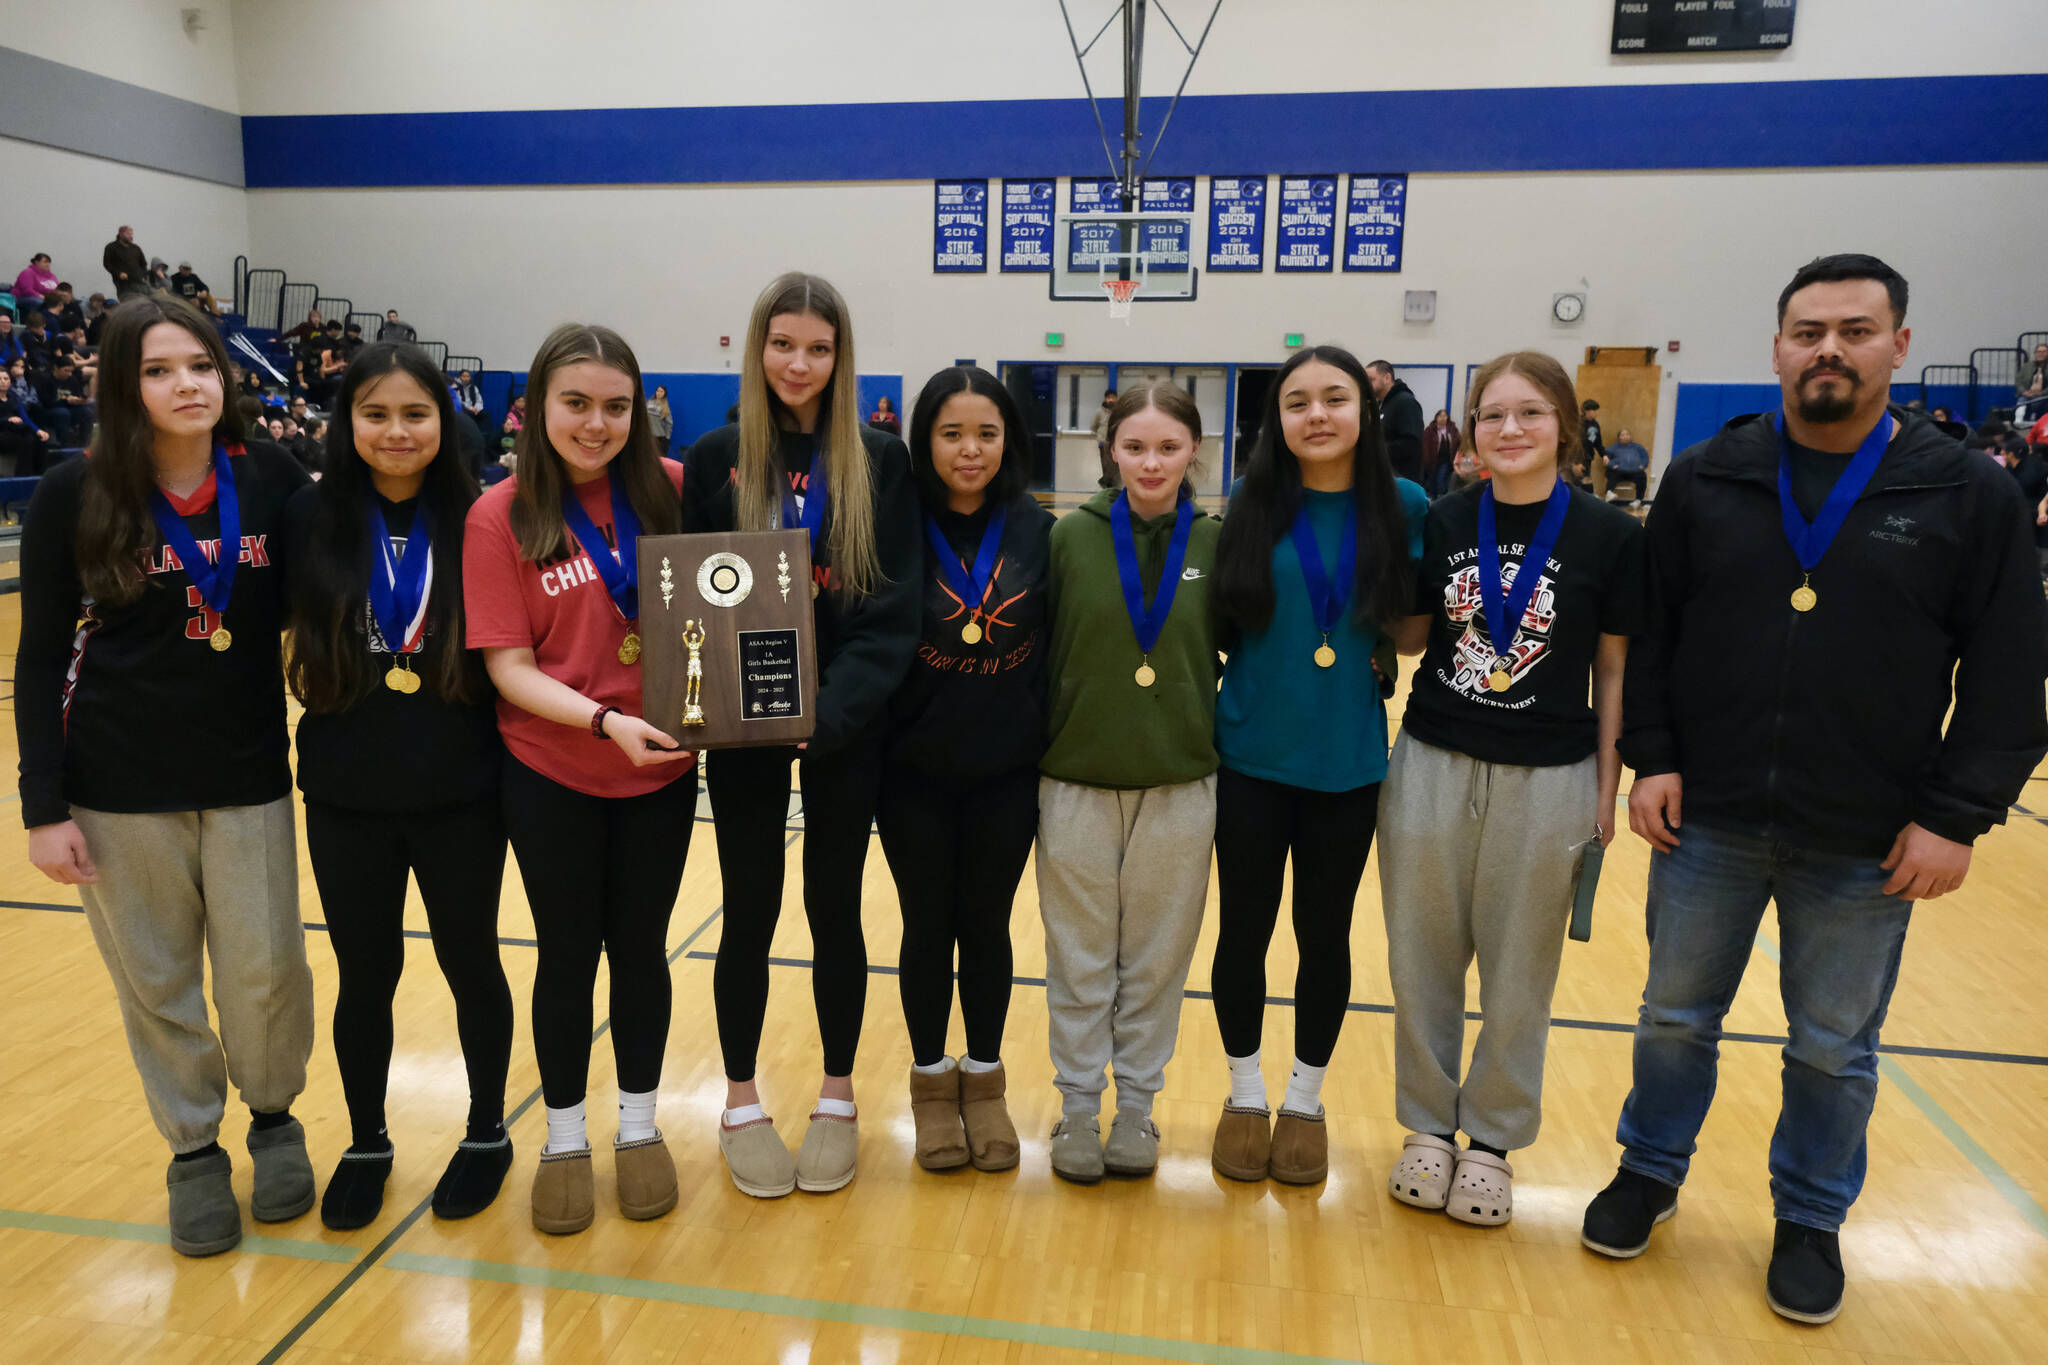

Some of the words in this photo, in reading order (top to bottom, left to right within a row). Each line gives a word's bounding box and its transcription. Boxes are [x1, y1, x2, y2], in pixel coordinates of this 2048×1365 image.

[1620, 4, 1648, 13] FOULS
[1674, 1, 1708, 12] PLAYER
[1713, 0, 1736, 10] FOUL
[1618, 38, 1646, 48] SCORE
[1688, 36, 1717, 46] MATCH
[1760, 34, 1788, 44] SCORE
[938, 213, 984, 227] SOFTBALL
[1006, 213, 1050, 227] SOFTBALL
[1218, 213, 1255, 226] SOCCER
[1348, 213, 1401, 226] BASKETBALL
[944, 228, 978, 237] 2016
[1011, 228, 1045, 237] 2017
[1080, 230, 1114, 238] 2017
[1148, 226, 1184, 234] 2018
[1219, 226, 1254, 236] 2021
[1287, 228, 1326, 236] 2023
[1355, 226, 1394, 236] 2023
[946, 240, 974, 254] STATE
[1014, 240, 1042, 254] STATE
[1082, 240, 1110, 252] STATE
[1151, 238, 1179, 251] STATE
[1221, 243, 1250, 255] STATE
[1290, 244, 1320, 256] STATE
[1358, 243, 1388, 255] STATE
[937, 253, 982, 266] CHAMPIONS
[1004, 253, 1050, 266] CHAMPIONS
[1211, 254, 1260, 266] CHAMPIONS
[1280, 254, 1316, 266] RUNNER
[1316, 254, 1329, 266] UP
[1349, 254, 1383, 266] RUNNER
[1384, 254, 1396, 266] UP
[1448, 551, 1466, 566] 1ST
[1511, 544, 1525, 556] SE
[1186, 567, 1200, 577] NIKE
[185, 585, 222, 639] 3
[762, 658, 791, 666] Basketball
[959, 658, 977, 673] IS
[748, 673, 792, 682] Champions
[1437, 668, 1470, 698] CULTURAL
[1470, 692, 1536, 710] TOURNAMENT
